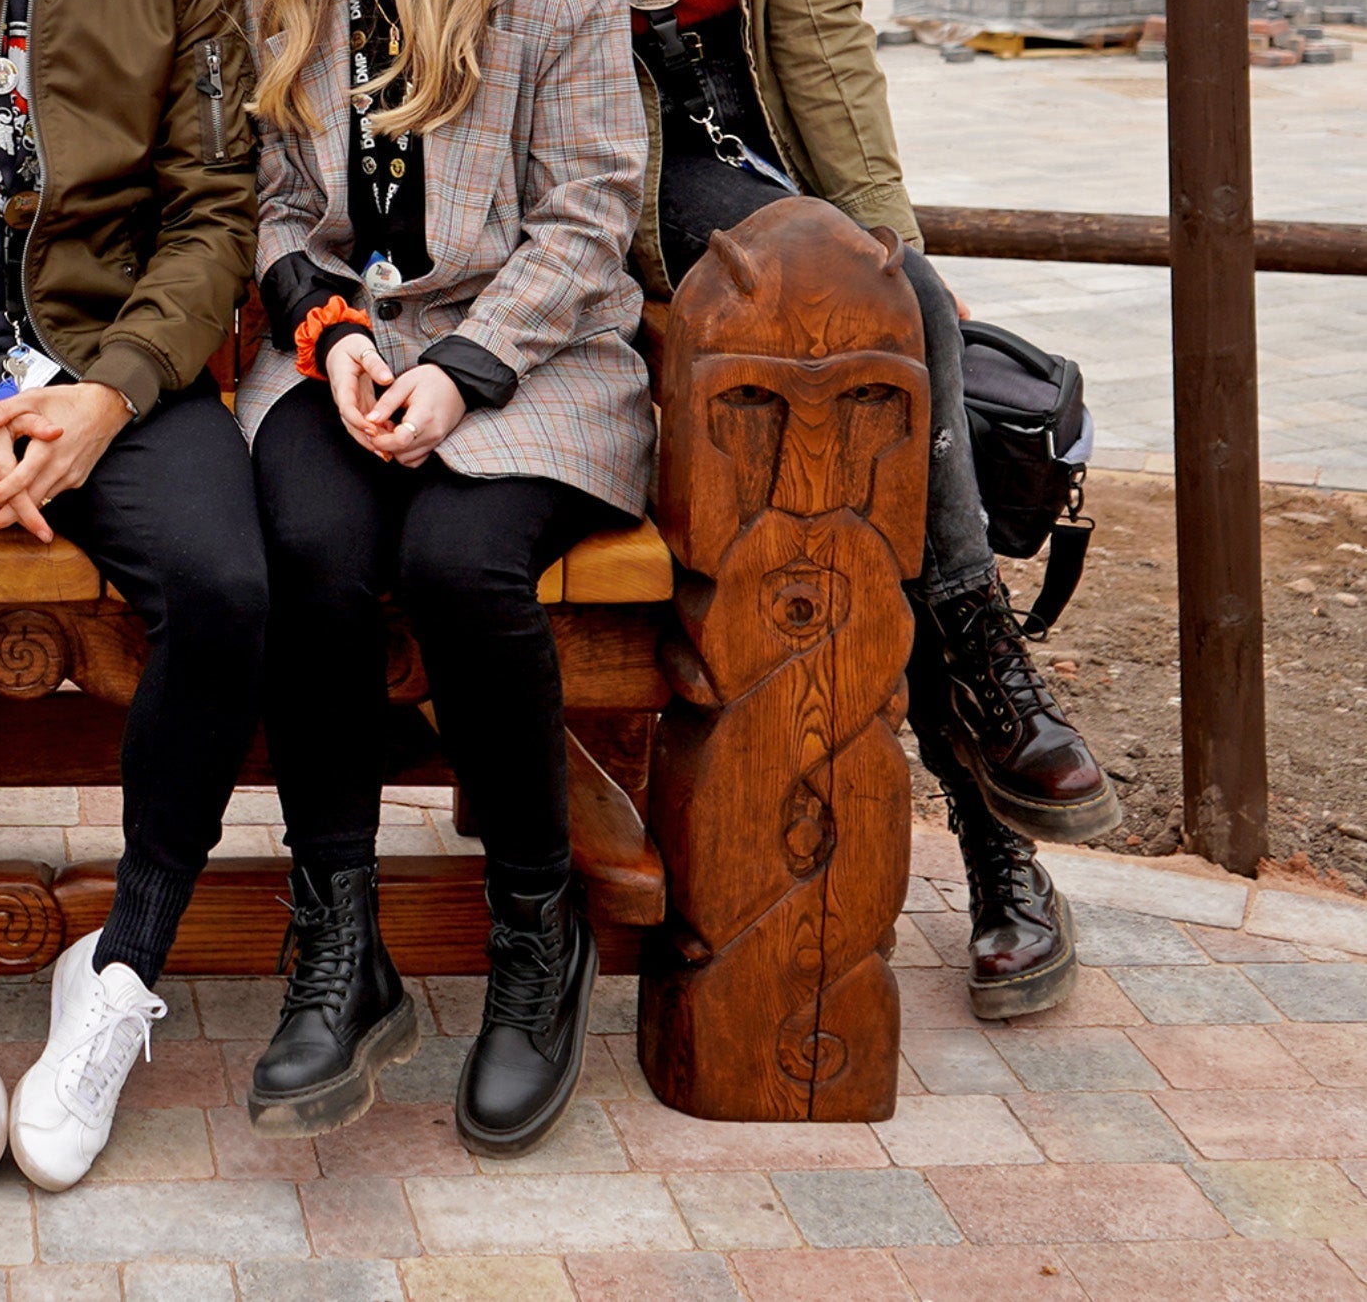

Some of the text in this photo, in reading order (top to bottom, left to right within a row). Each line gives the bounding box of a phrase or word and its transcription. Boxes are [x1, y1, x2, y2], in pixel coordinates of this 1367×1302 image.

[355, 52, 369, 84] DMP
[360, 117, 375, 149] DMP
[397, 129, 410, 152] MP
